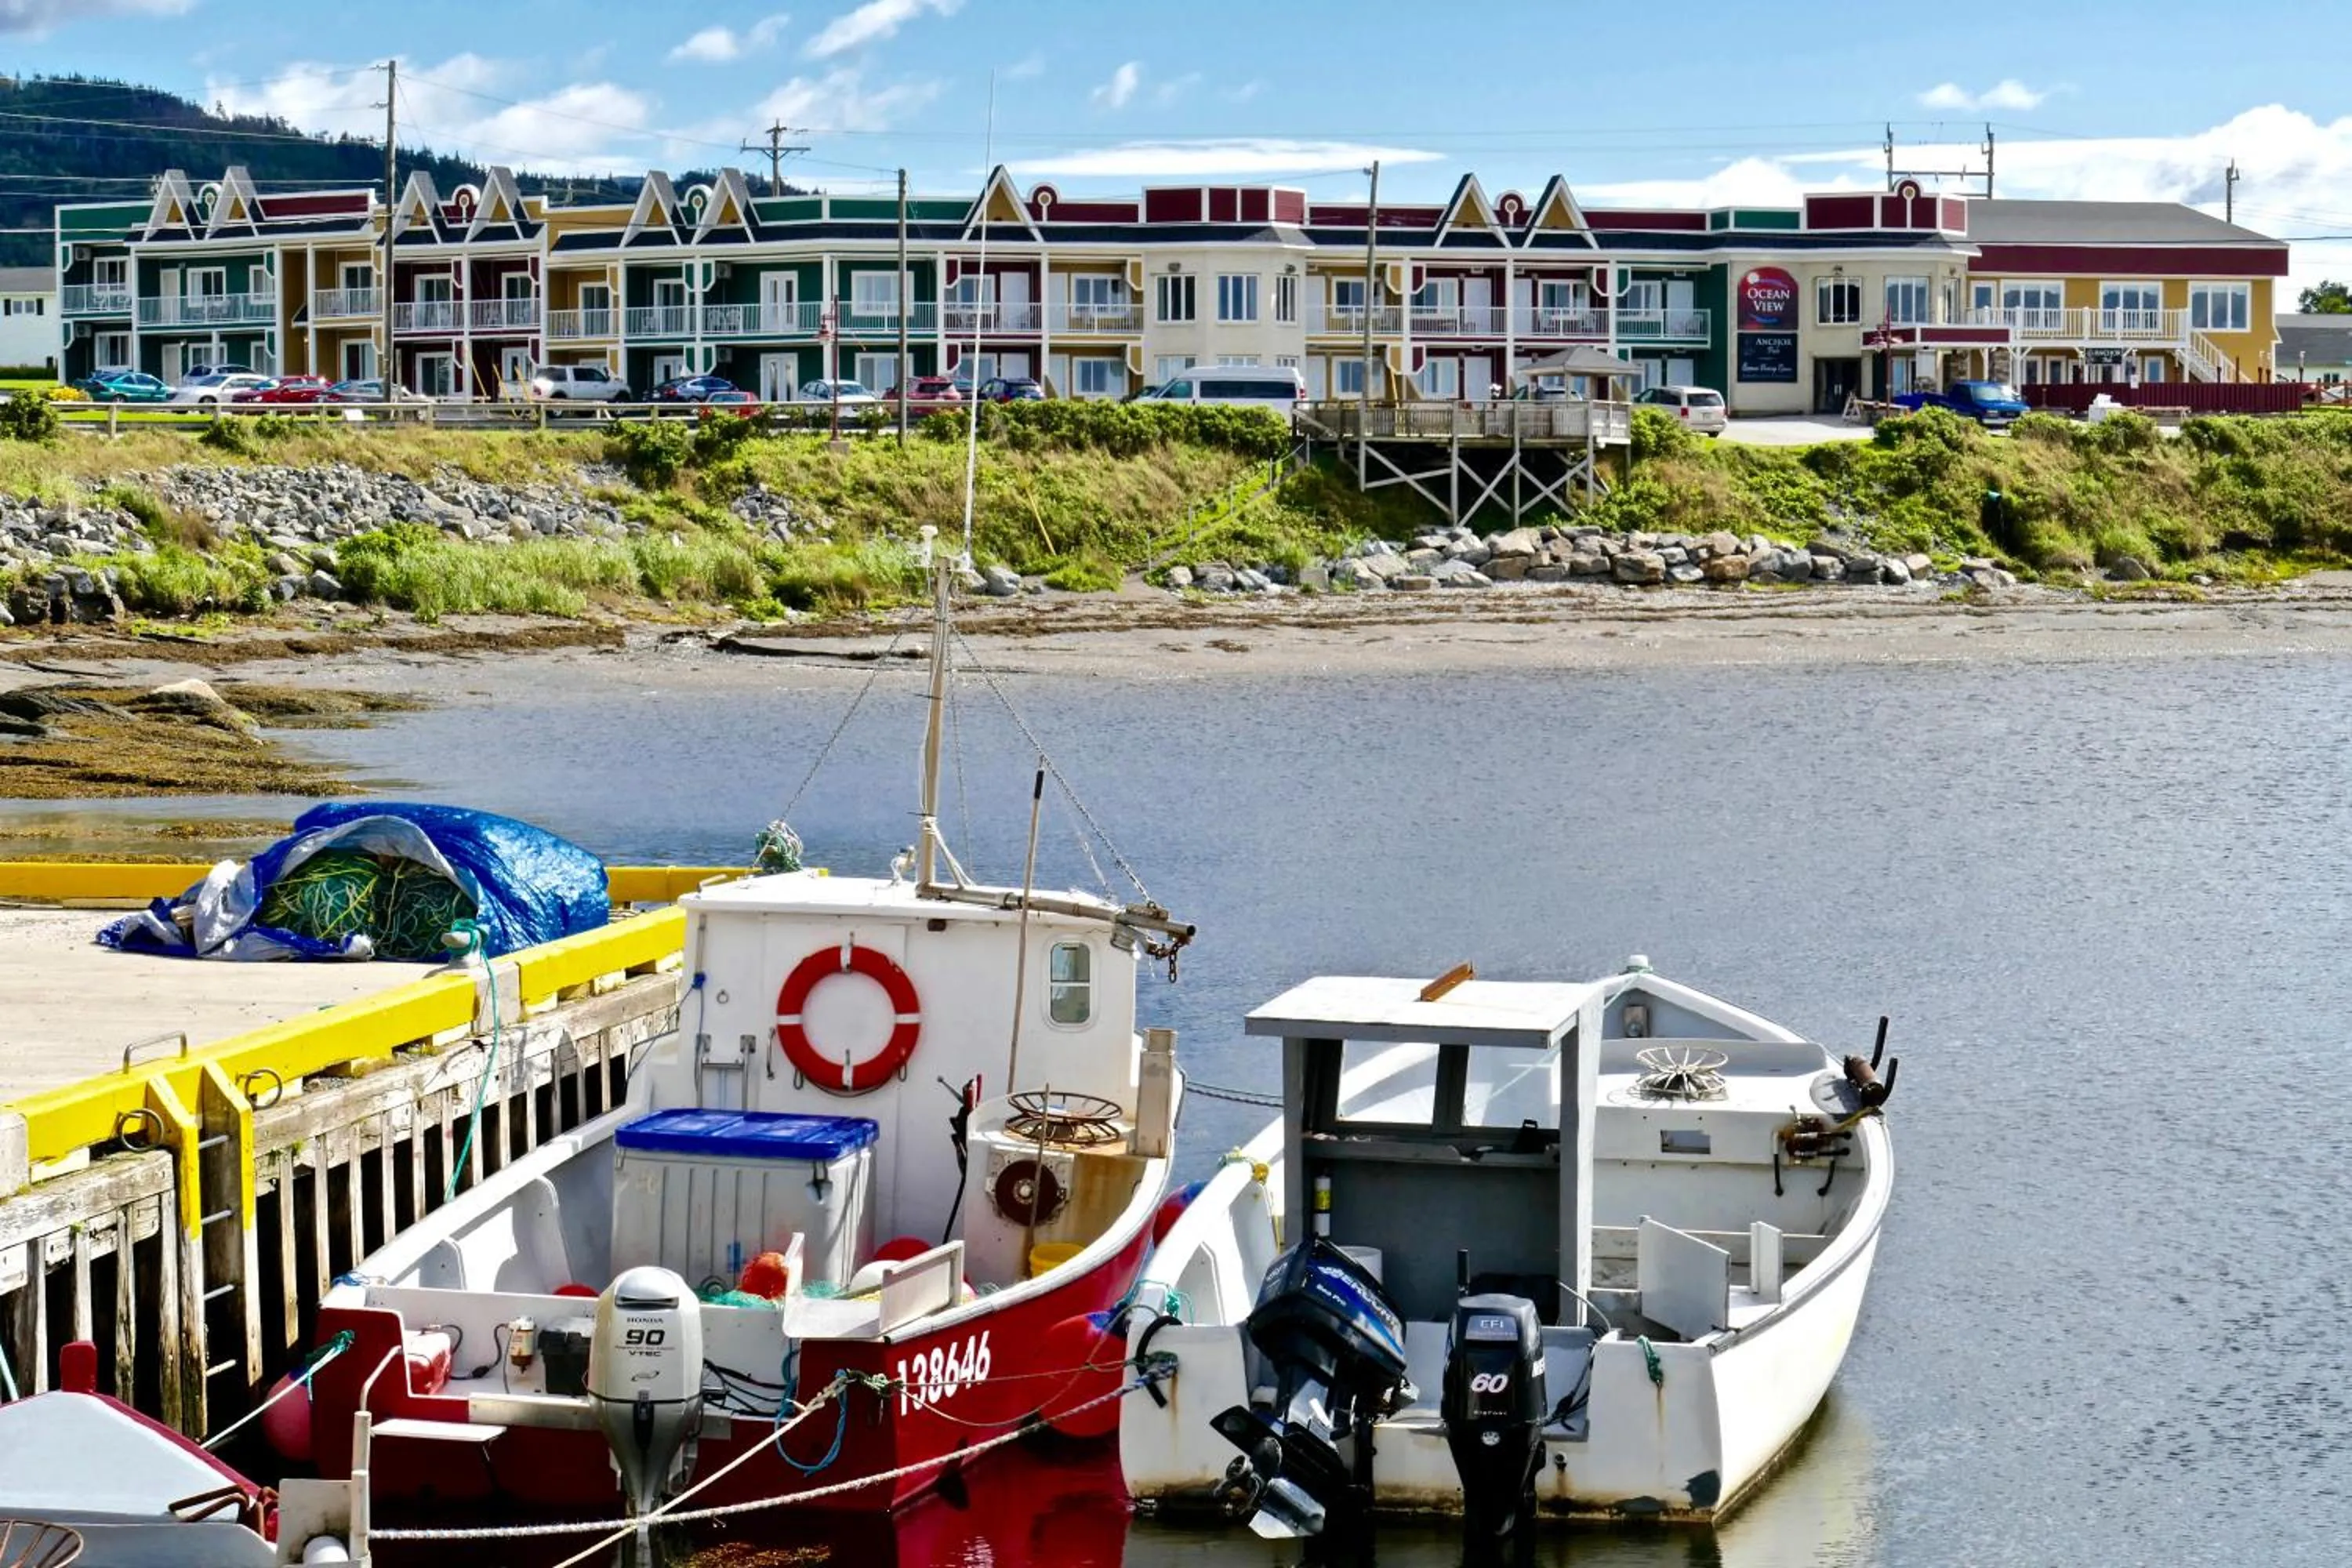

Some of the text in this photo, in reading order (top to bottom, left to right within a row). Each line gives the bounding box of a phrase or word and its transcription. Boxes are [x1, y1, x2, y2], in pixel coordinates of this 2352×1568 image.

[1748, 289, 1790, 299] OCEAN
[1754, 301, 1784, 311] VIEW
[1756, 338, 1792, 347] ANCHOR
[1480, 1319, 1504, 1328] EFI
[626, 1330, 665, 1345] 90
[898, 1330, 991, 1416] 138646
[1471, 1373, 1508, 1393] 60
